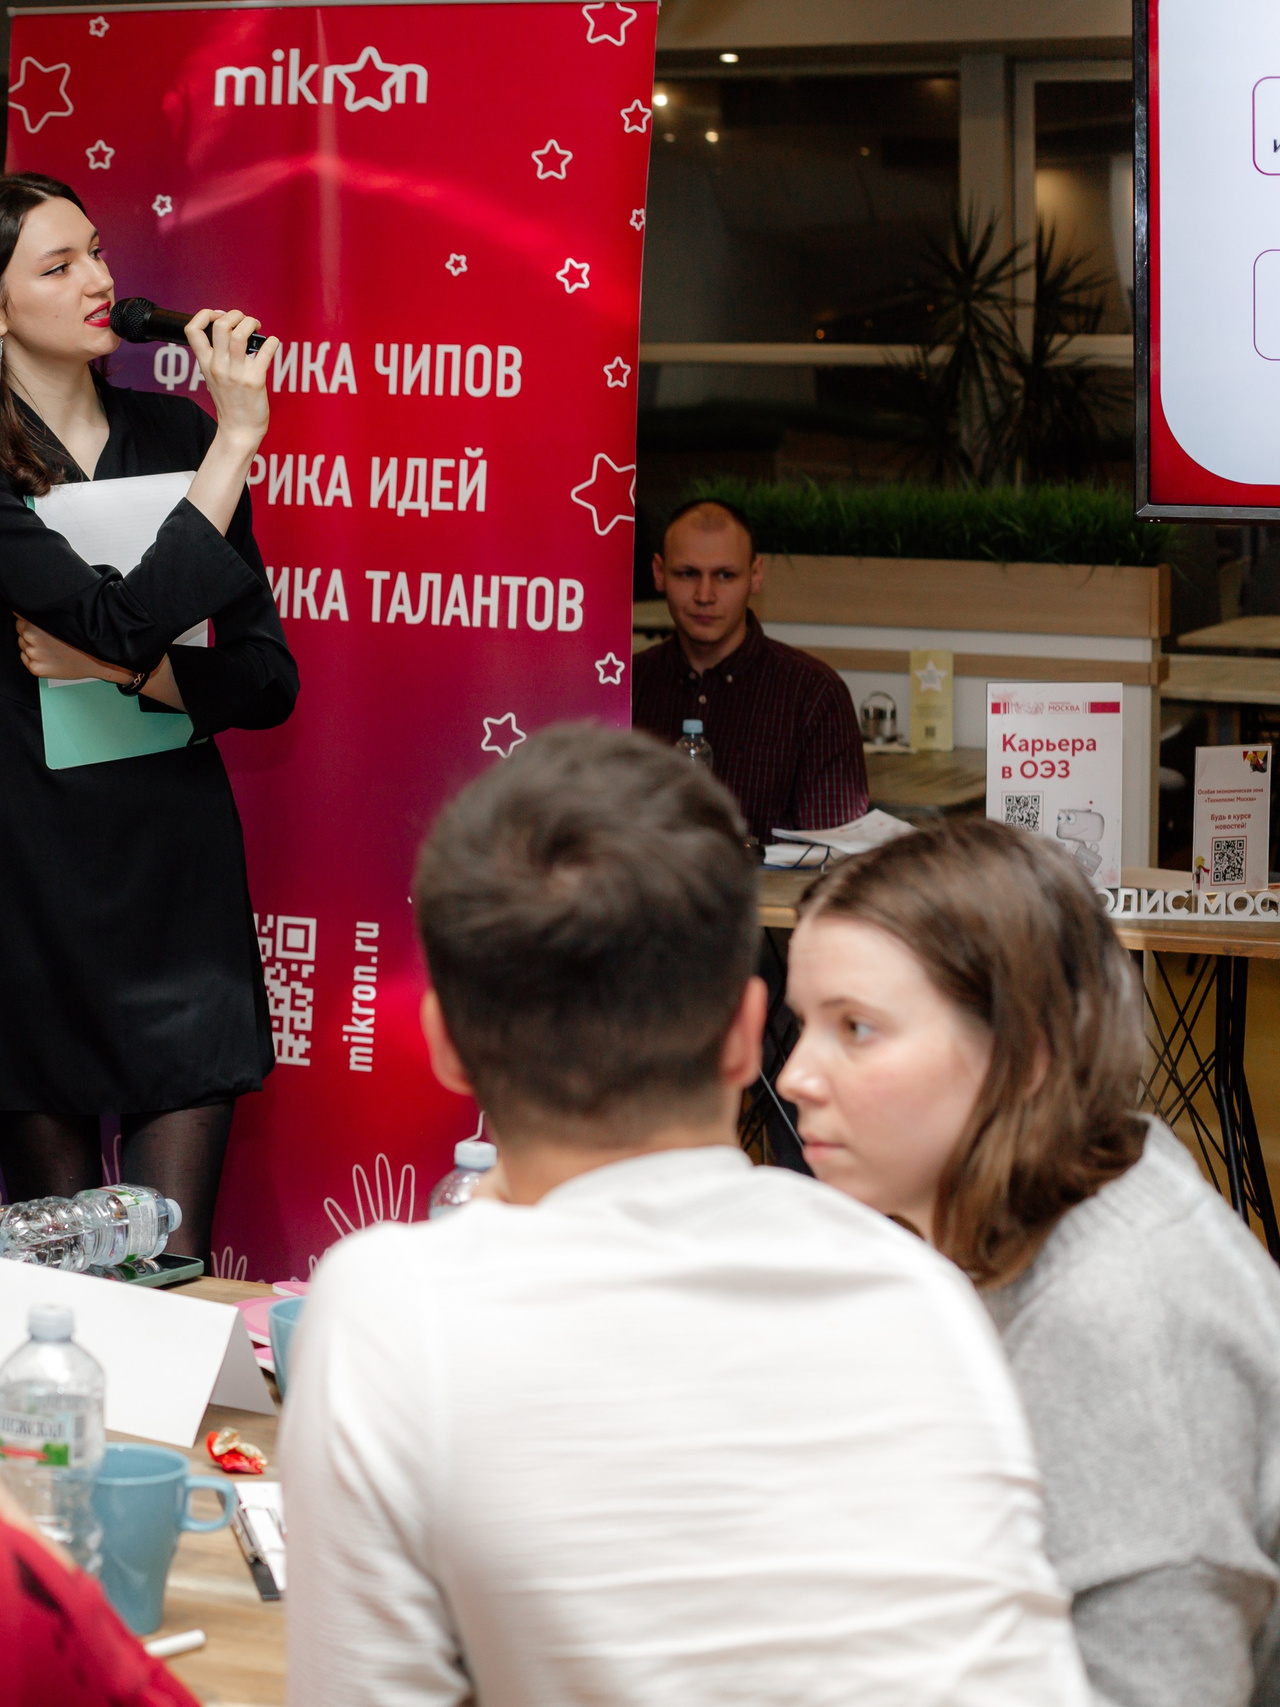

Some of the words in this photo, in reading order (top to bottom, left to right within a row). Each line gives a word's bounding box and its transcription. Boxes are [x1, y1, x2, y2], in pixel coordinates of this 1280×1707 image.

[374, 343, 523, 398] ЧИПОВ
[369, 447, 488, 518] ИДЕЙ
[365, 569, 585, 632] ТАЛАНТОВ
[1048, 704, 1080, 712] МОСКВА
[1002, 733, 1097, 757] Карьера
[1001, 766, 1012, 779] в
[1020, 760, 1071, 779] ОЭЗ
[1210, 813, 1226, 822] Будь
[1233, 813, 1252, 821] курсе
[1215, 822, 1247, 830] новостей!
[342, 921, 380, 1073] mikron.ru
